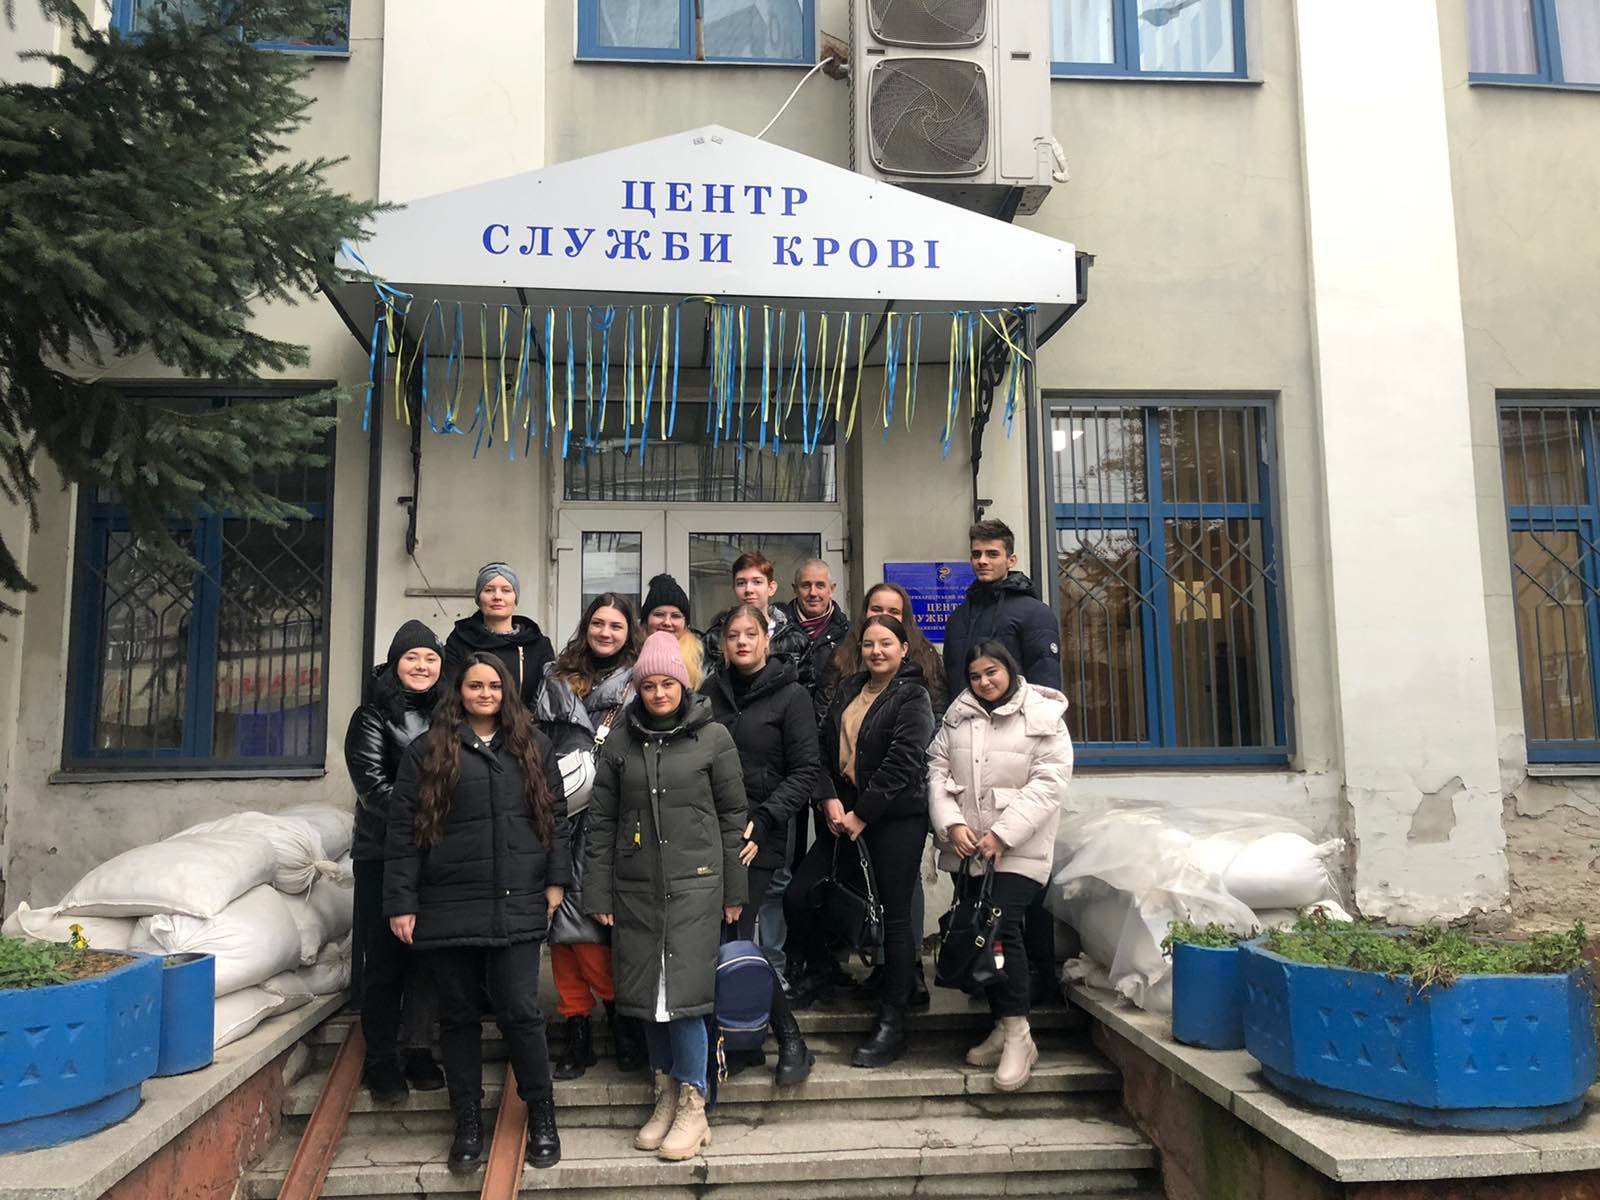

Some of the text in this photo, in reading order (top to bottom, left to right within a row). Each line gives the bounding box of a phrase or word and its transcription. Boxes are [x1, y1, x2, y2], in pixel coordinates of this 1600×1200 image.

[621, 179, 808, 218] ЦЕНТР
[482, 223, 940, 269] СЛУЖБИ КРОВІ
[927, 603, 962, 612] ЦЕНТ
